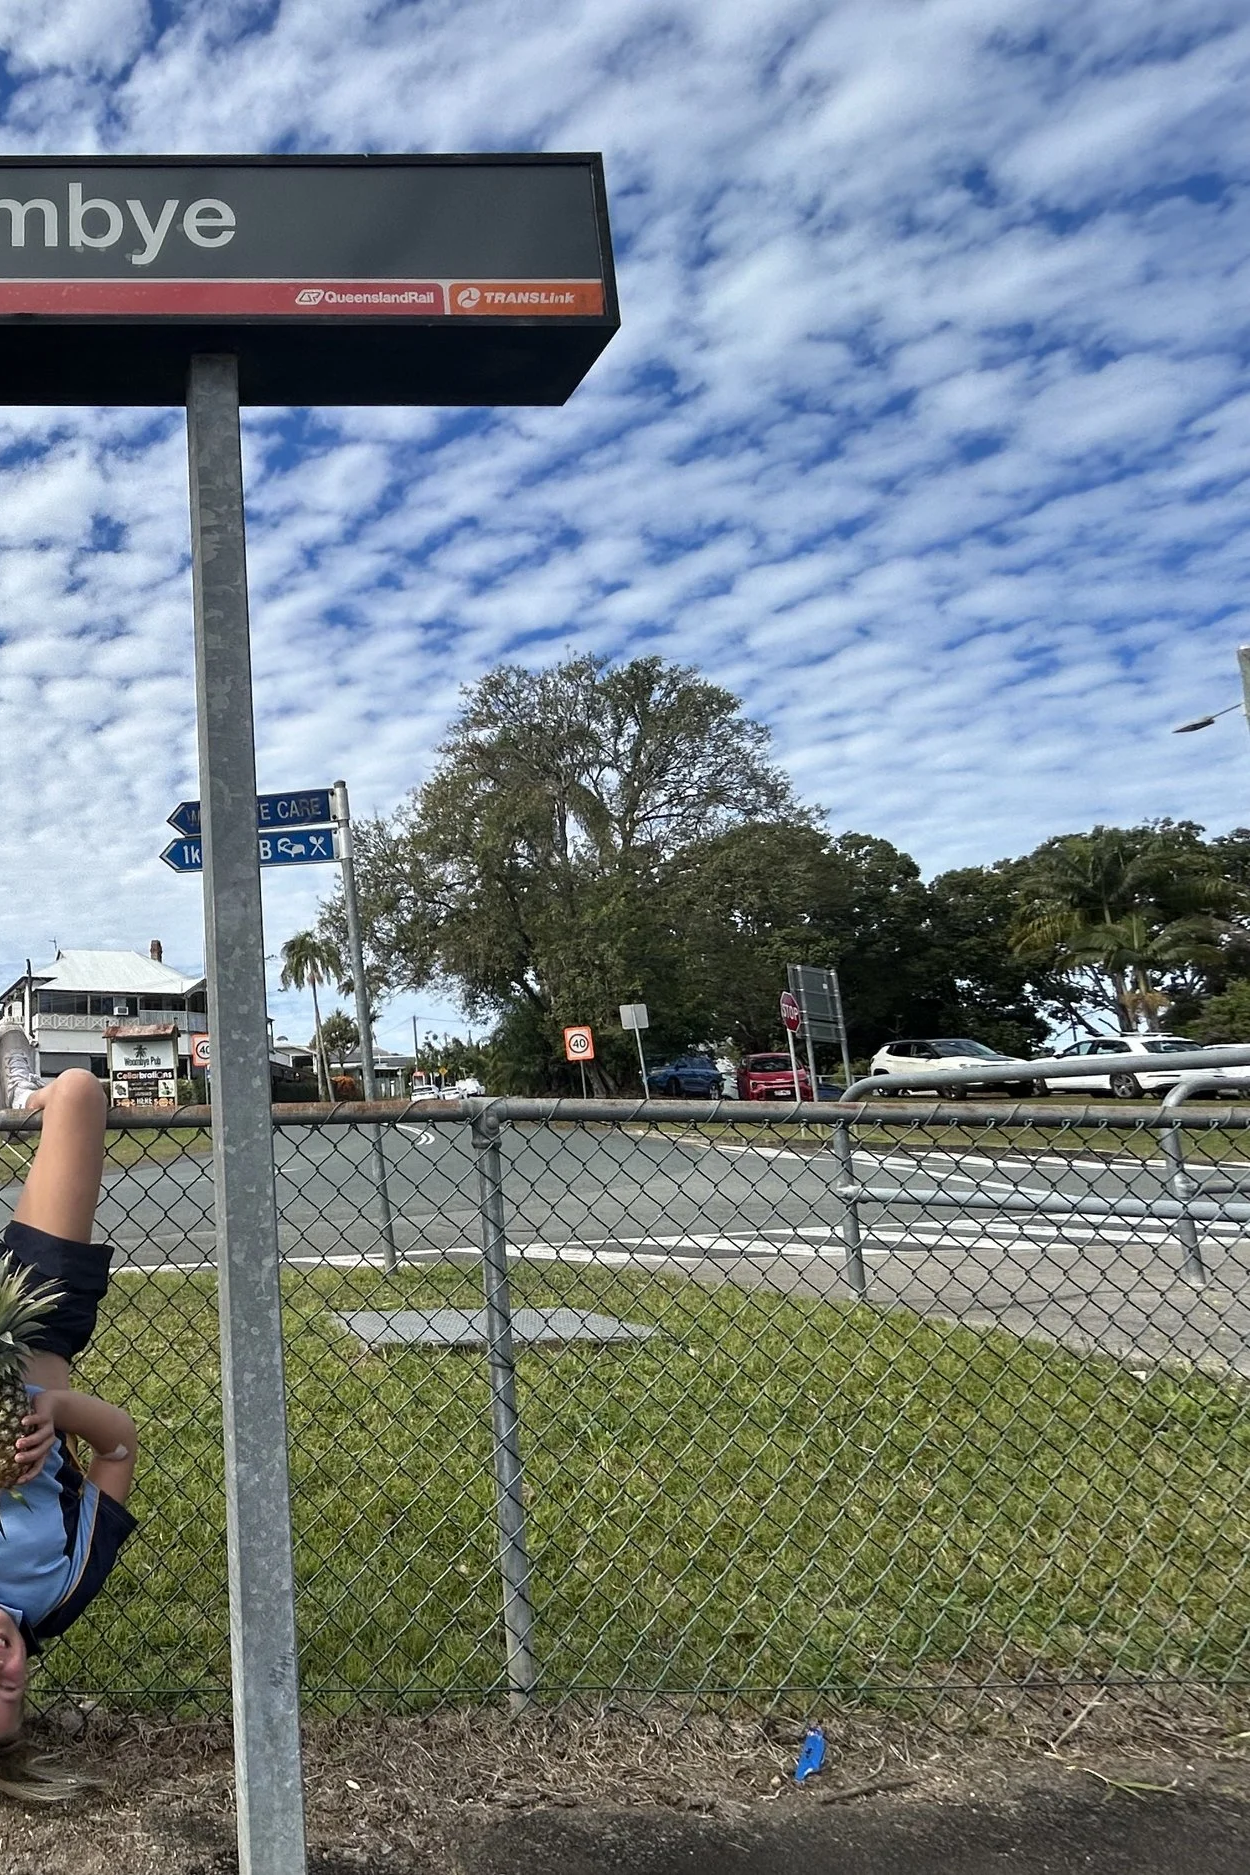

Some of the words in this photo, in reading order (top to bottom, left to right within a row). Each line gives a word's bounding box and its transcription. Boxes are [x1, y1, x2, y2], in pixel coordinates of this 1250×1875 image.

[324, 291, 435, 304] QueenslandRail
[484, 292, 575, 304] TRANSLink
[277, 798, 322, 818] CARE
[183, 845, 201, 864] 1k
[782, 1003, 799, 1020] STOP
[573, 1039, 586, 1048] 40
